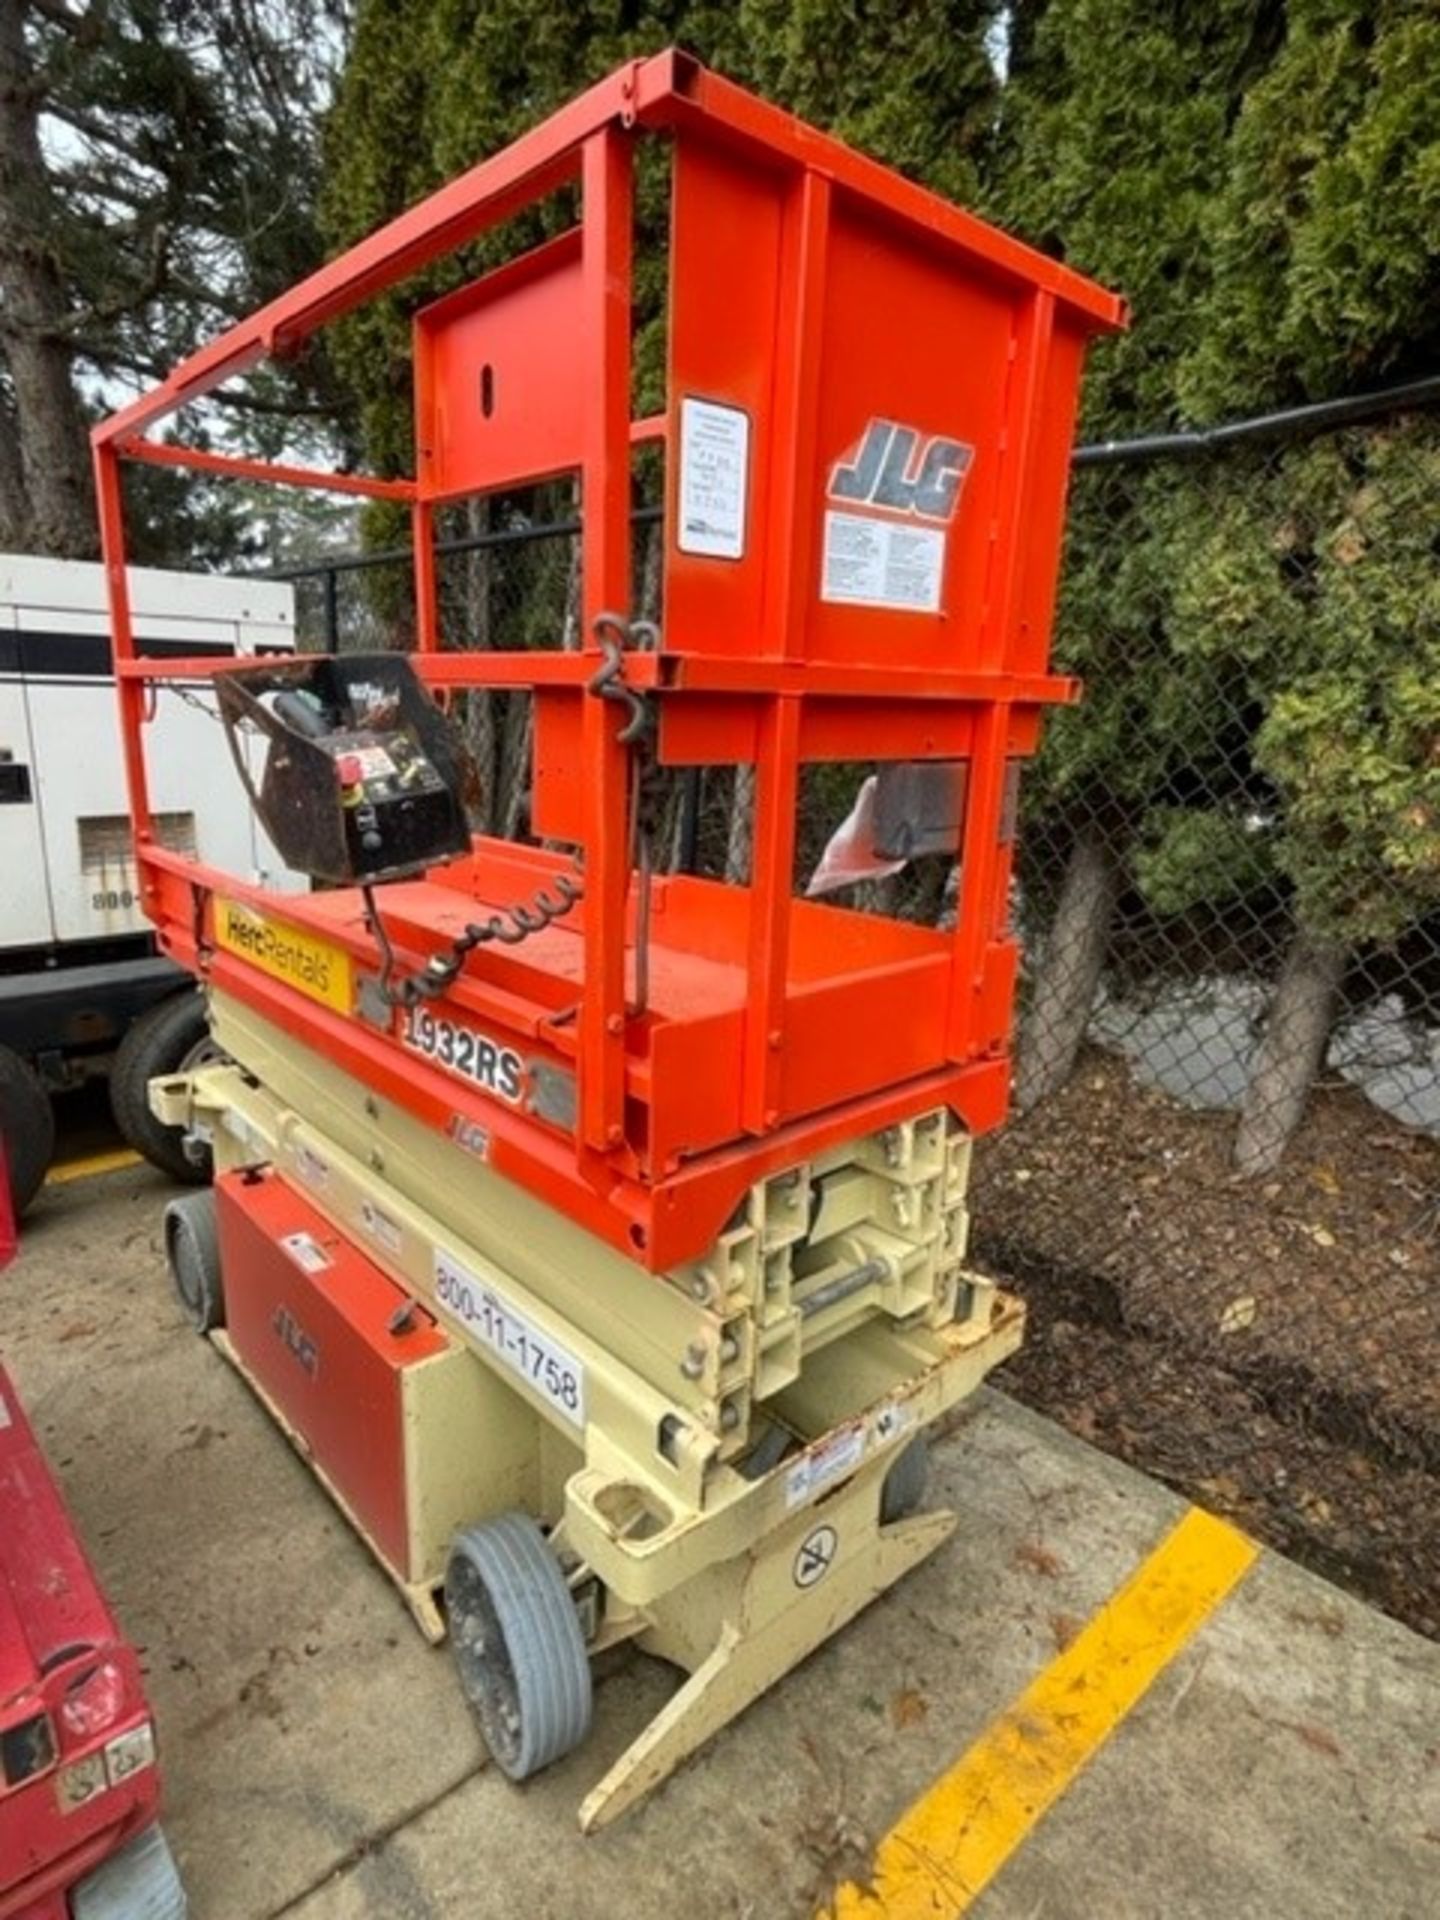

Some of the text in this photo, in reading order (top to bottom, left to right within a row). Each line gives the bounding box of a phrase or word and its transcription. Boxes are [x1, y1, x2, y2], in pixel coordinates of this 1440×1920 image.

[827, 418, 974, 522] JLG
[406, 1008, 522, 1100] 1932RS
[436, 1267, 578, 1410] 800-11-1758
